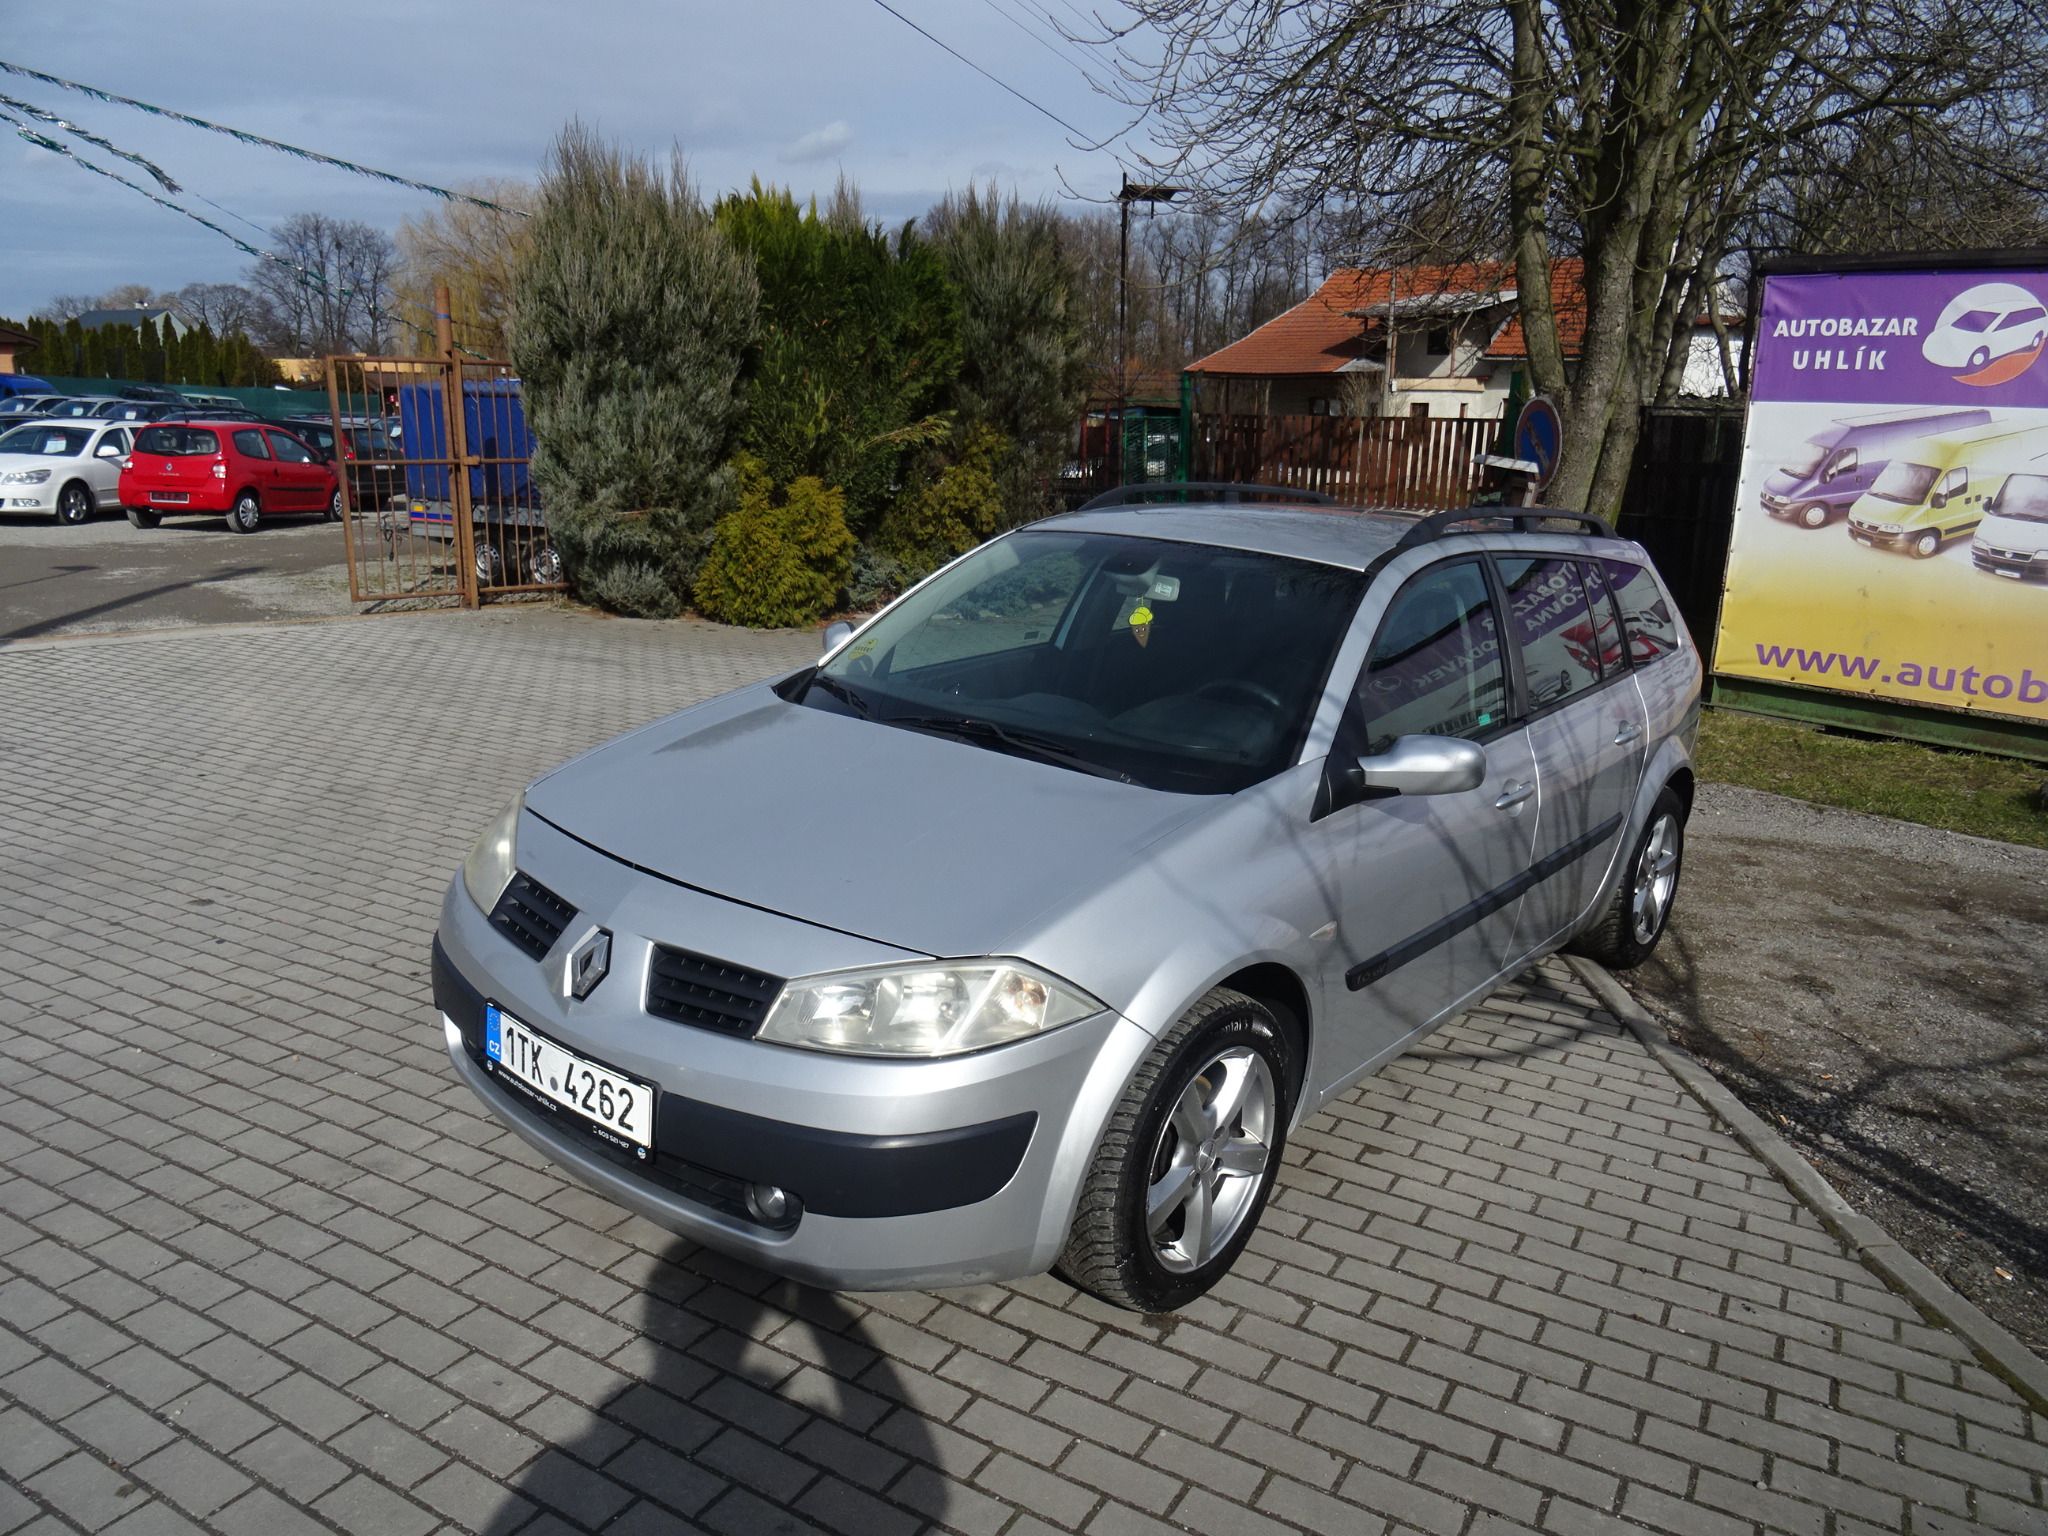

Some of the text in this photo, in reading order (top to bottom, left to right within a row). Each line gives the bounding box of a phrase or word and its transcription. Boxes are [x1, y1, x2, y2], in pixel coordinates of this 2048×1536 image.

[1773, 317, 1918, 337] AUTOBAZAR
[1792, 345, 1887, 370] UHLÍK
[1755, 643, 2048, 704] www.autob
[489, 1039, 500, 1055] CZ
[506, 1026, 634, 1132] 1TK 4262
